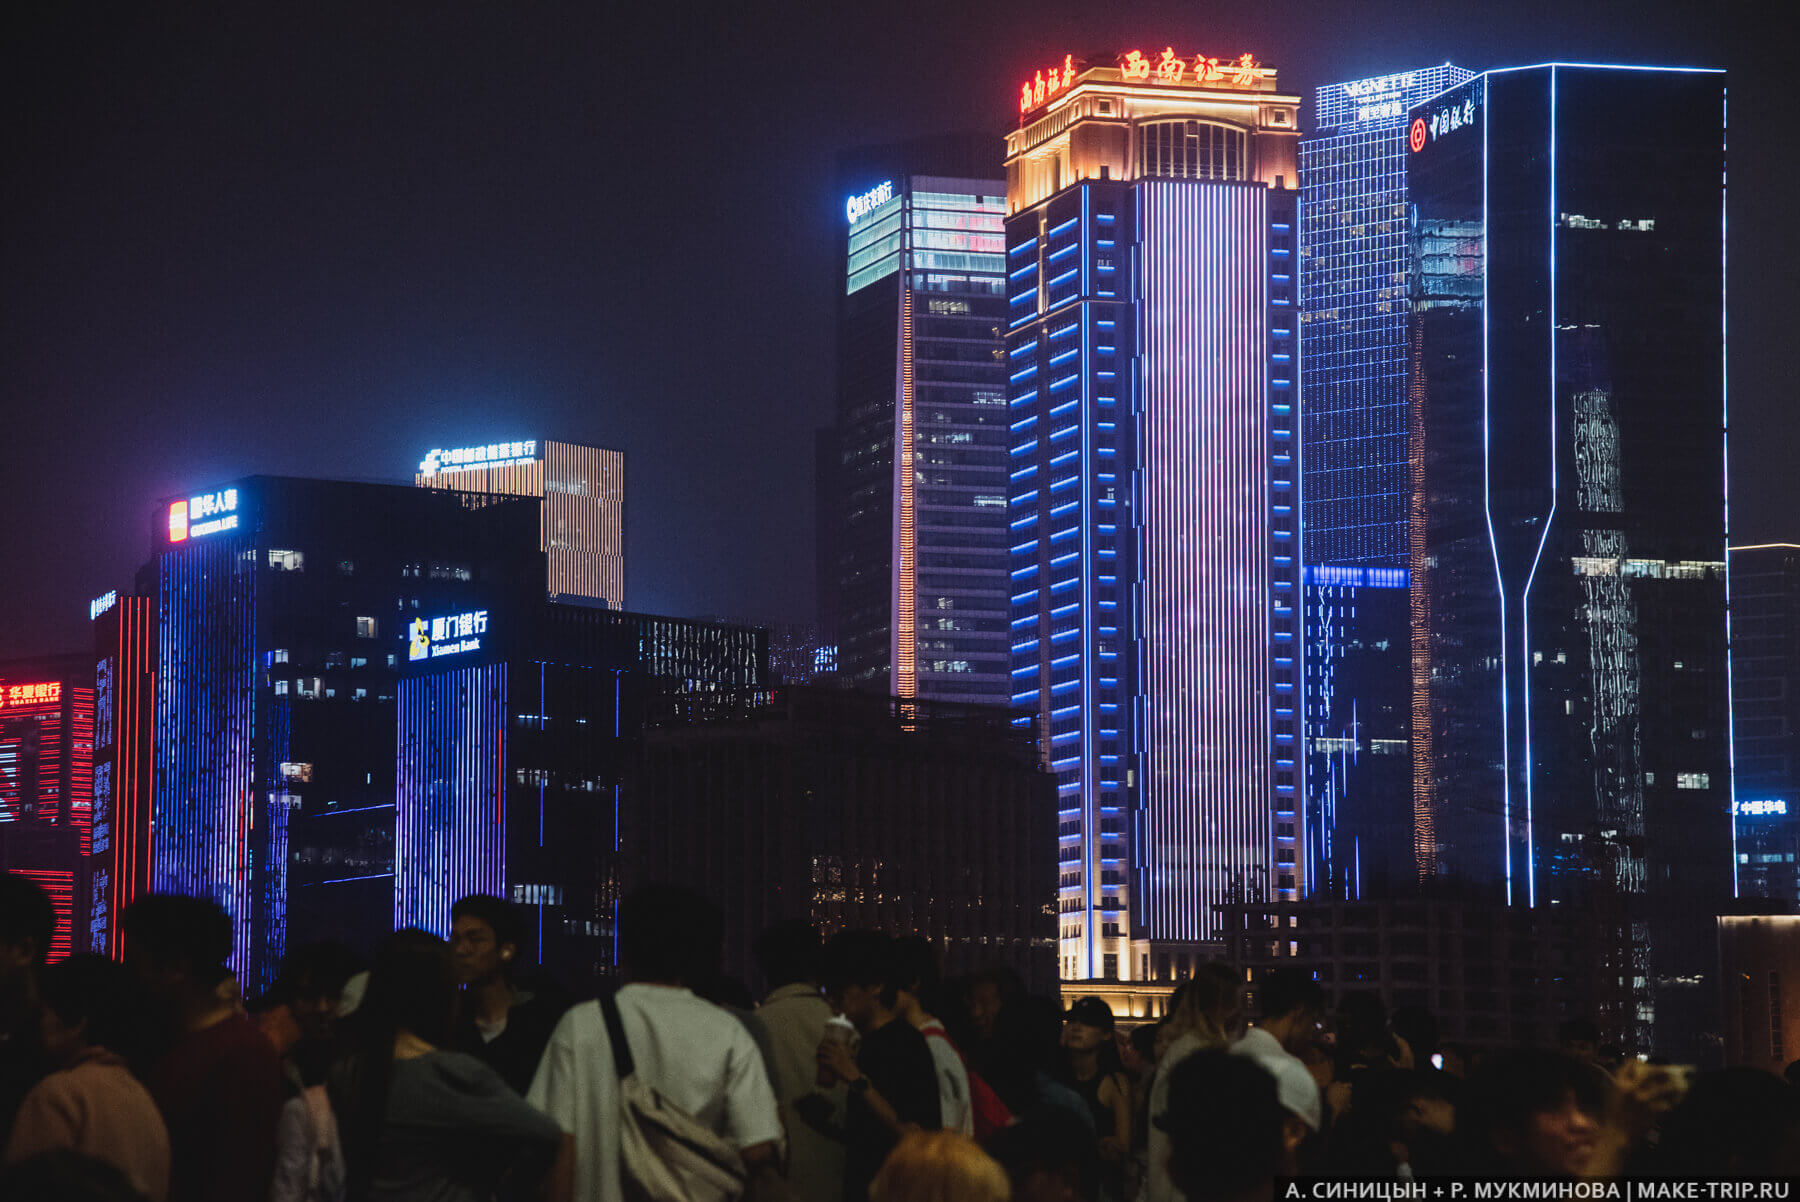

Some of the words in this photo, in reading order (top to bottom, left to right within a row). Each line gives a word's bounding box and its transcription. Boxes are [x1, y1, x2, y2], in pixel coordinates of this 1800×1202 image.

[1120, 47, 1265, 86] 西南证券
[1343, 73, 1417, 97] VIGNETTE
[1429, 98, 1476, 142] 中国银行
[431, 610, 488, 641] 厦门银行
[432, 643, 460, 657] Xiamen
[461, 637, 480, 652] Bank
[9, 682, 61, 699] 华夏银行
